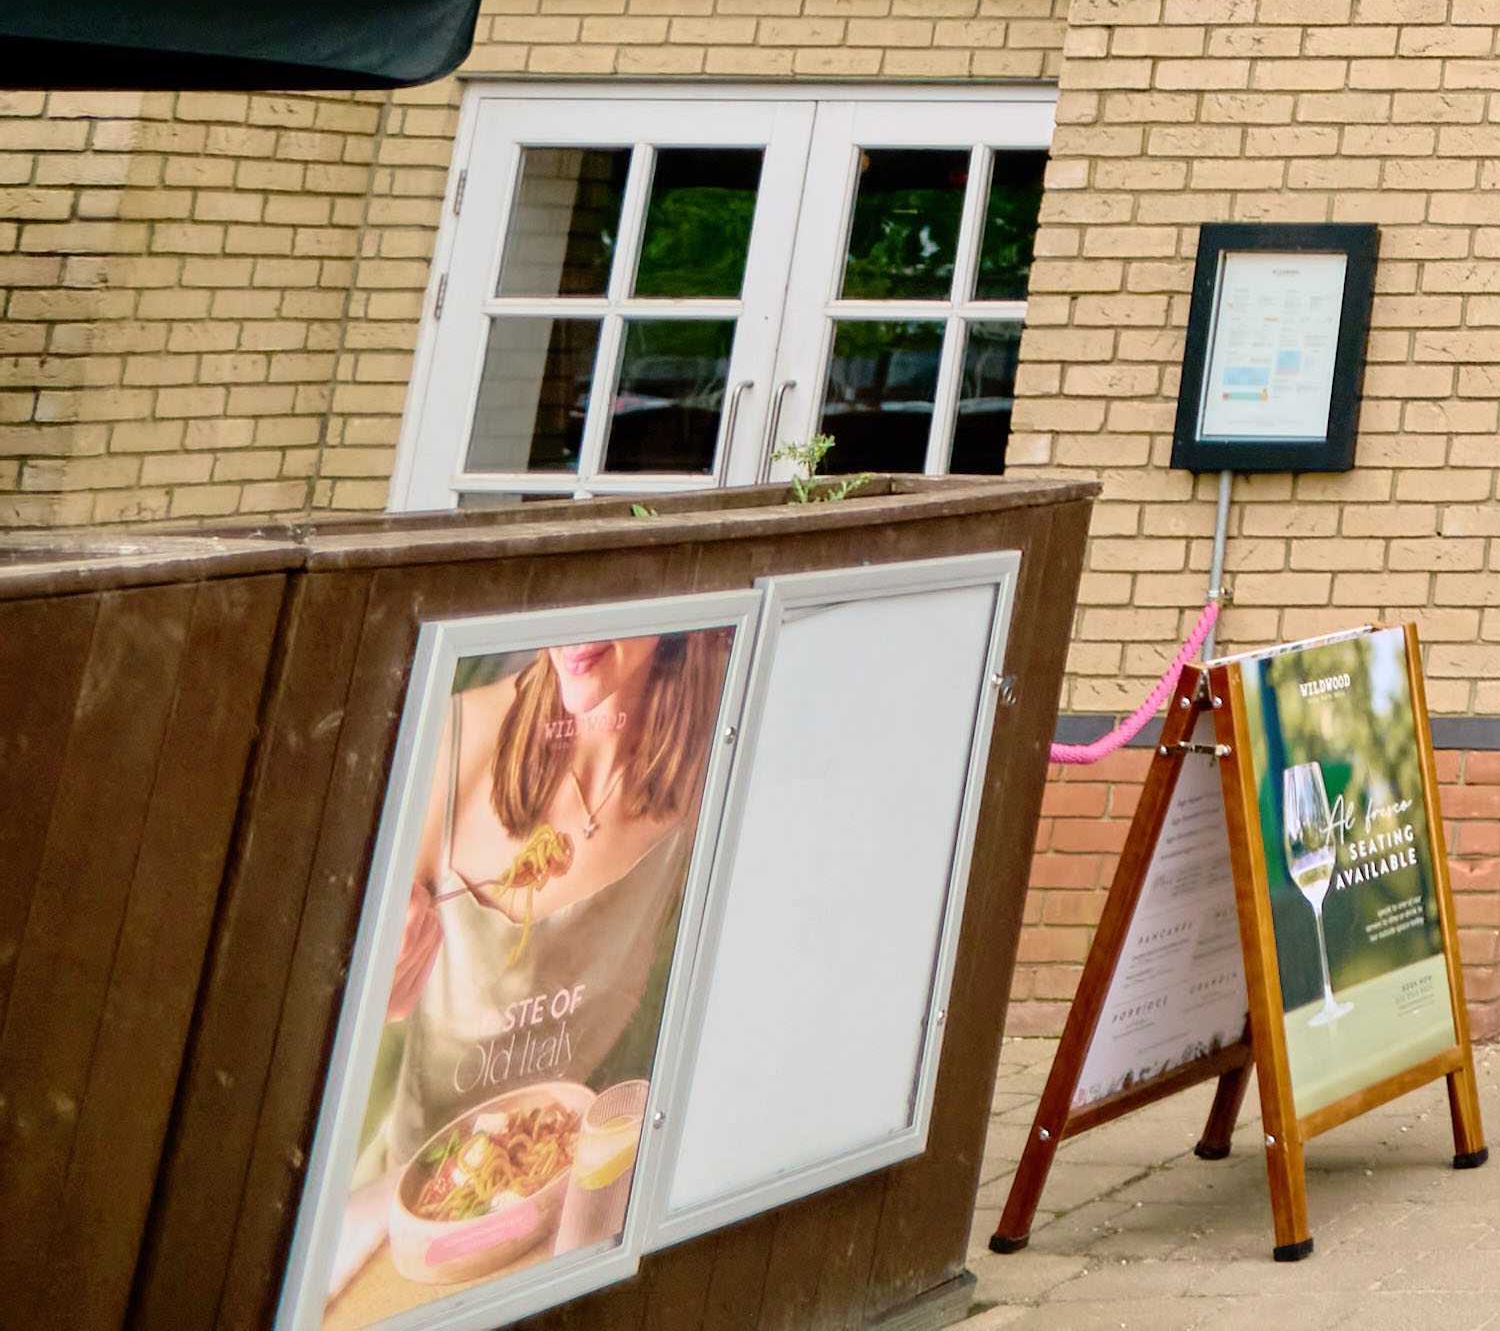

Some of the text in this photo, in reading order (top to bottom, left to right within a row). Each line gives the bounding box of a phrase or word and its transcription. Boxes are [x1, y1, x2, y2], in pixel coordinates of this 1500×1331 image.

[1299, 673, 1351, 697] WILDWOOD
[1350, 824, 1414, 861] SEATING
[1335, 847, 1417, 891] AVAILABLE
[550, 984, 586, 1020] OF
[455, 1034, 516, 1093] Old
